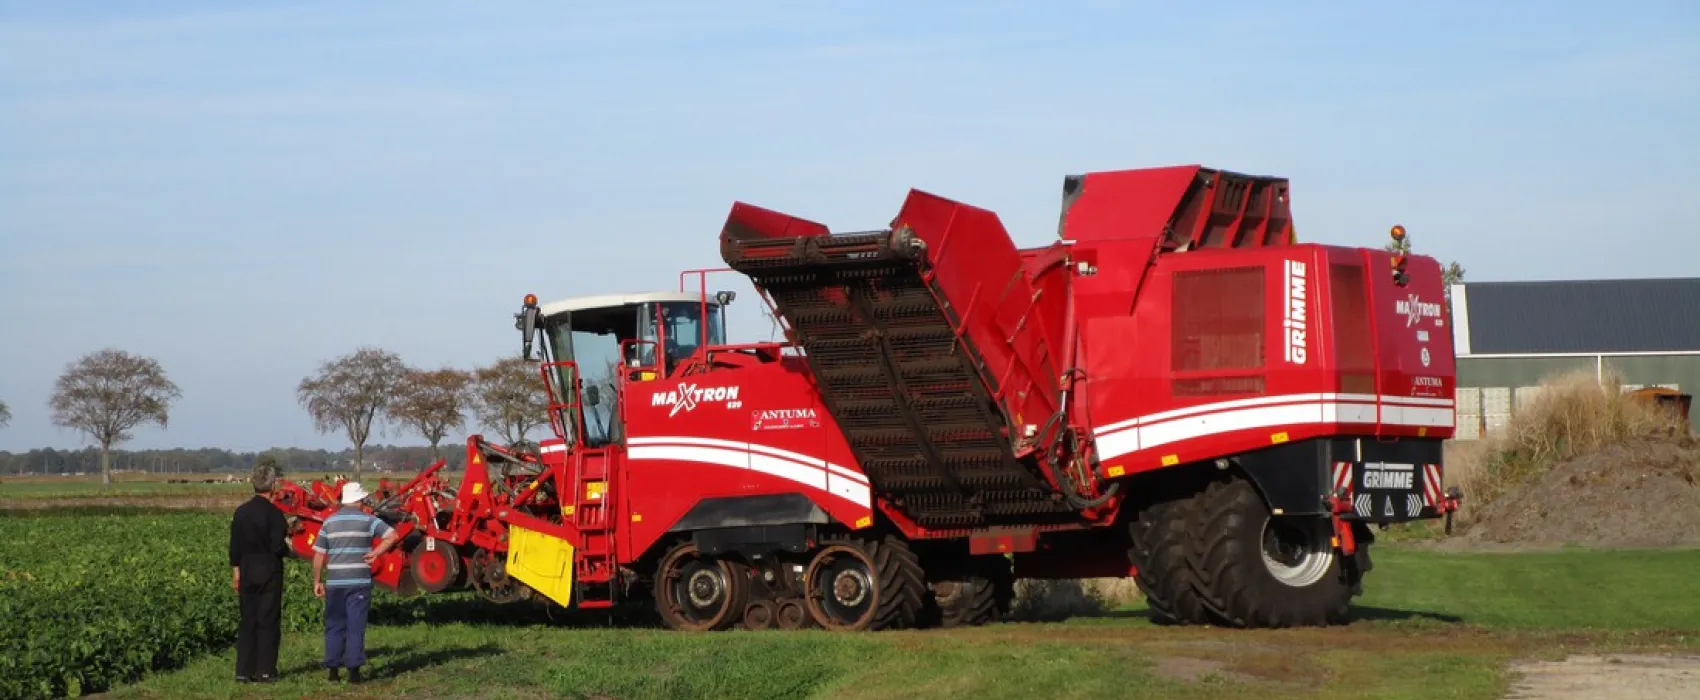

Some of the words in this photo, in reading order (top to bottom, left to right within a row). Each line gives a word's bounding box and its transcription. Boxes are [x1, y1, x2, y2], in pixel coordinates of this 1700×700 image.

[1291, 261, 1306, 364] GRIMME
[1396, 294, 1441, 328] MAXTRON
[1414, 376, 1443, 387] ANTUMA
[651, 382, 739, 418] MAXTRON
[760, 408, 816, 420] ANTUMA
[1363, 471, 1414, 489] GRIMME
